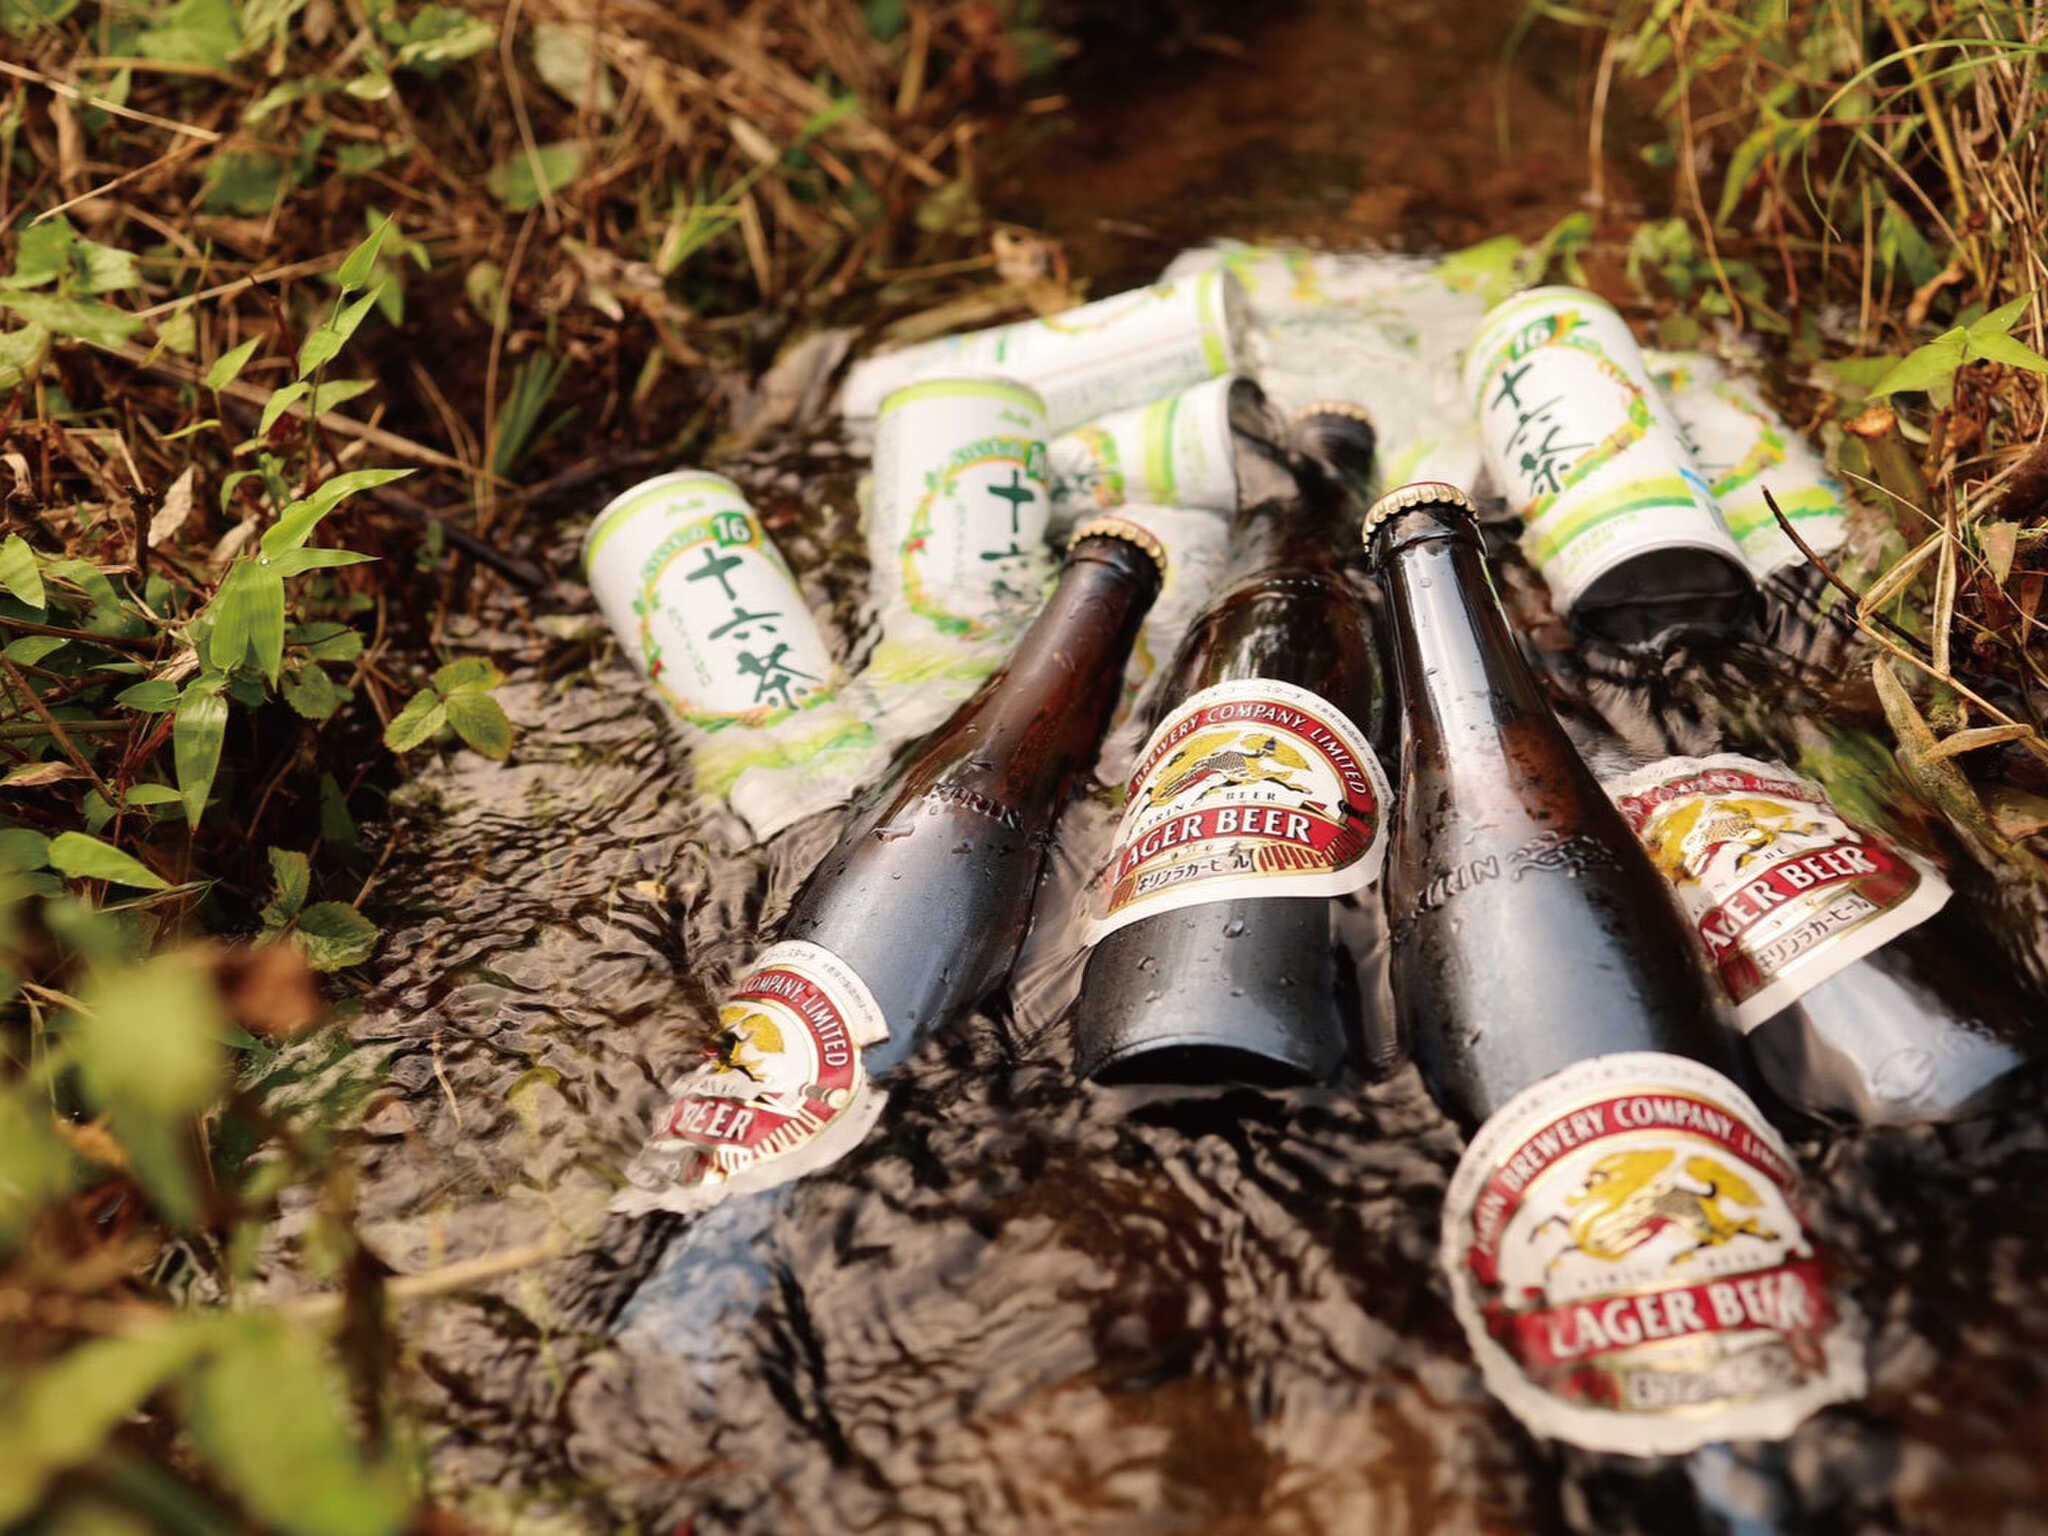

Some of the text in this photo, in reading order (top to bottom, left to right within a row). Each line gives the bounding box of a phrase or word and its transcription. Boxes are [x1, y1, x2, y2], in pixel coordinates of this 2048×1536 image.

[1514, 326, 1549, 354] 16
[1491, 362, 1596, 497] 十六茶
[713, 515, 750, 542] 16
[685, 547, 823, 710] 十六茶
[1309, 727, 1367, 795] LIMITED
[1215, 808, 1312, 844] BEER
[1701, 845, 1878, 959] AGER BEER
[801, 993, 849, 1067] LIMITED
[1501, 1107, 1606, 1193] BREWERY
[1550, 1289, 1706, 1358] LAGER
